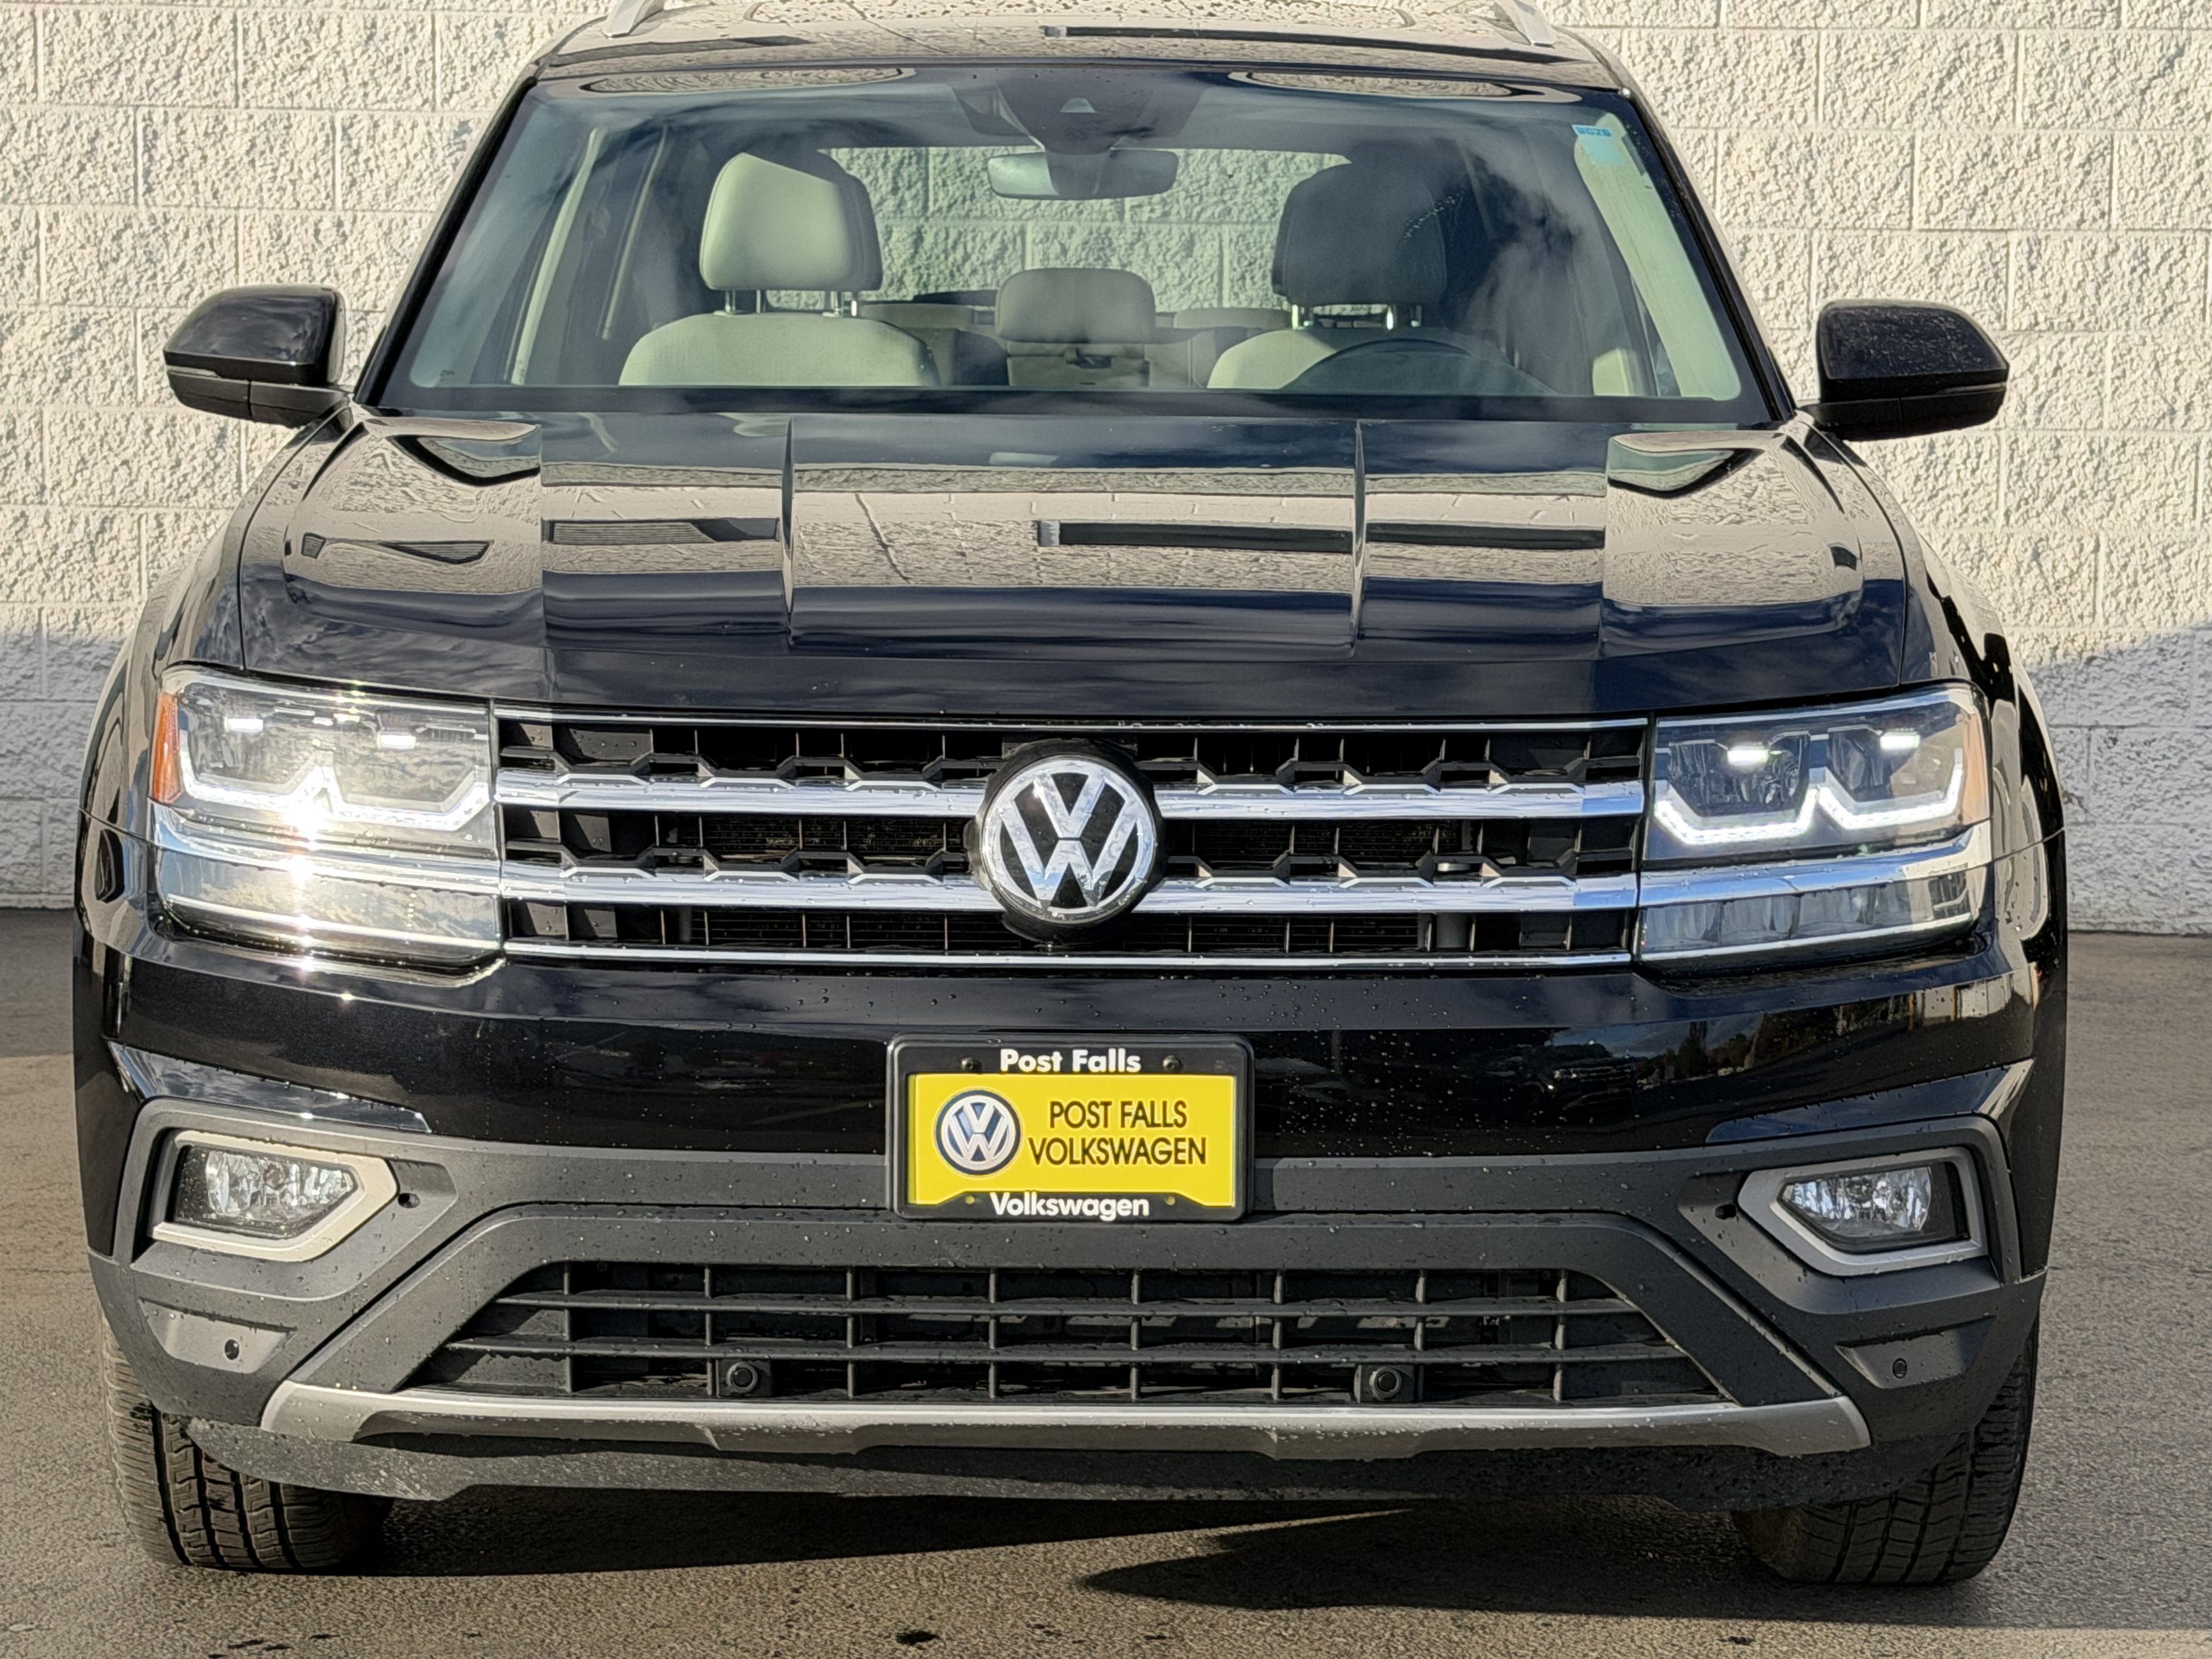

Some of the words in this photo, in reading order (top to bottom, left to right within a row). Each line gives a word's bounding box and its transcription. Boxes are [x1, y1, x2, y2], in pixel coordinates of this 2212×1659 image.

[989, 763, 1148, 915] VW
[1000, 1048, 1063, 1072] Post
[1072, 1048, 1141, 1073] Falls
[1049, 1100, 1113, 1128] POST
[1120, 1100, 1187, 1128] FALLS
[940, 1095, 1016, 1170] VW
[1028, 1137, 1206, 1165] VOLKSWAGEN
[989, 1191, 1150, 1222] Volkswagen
